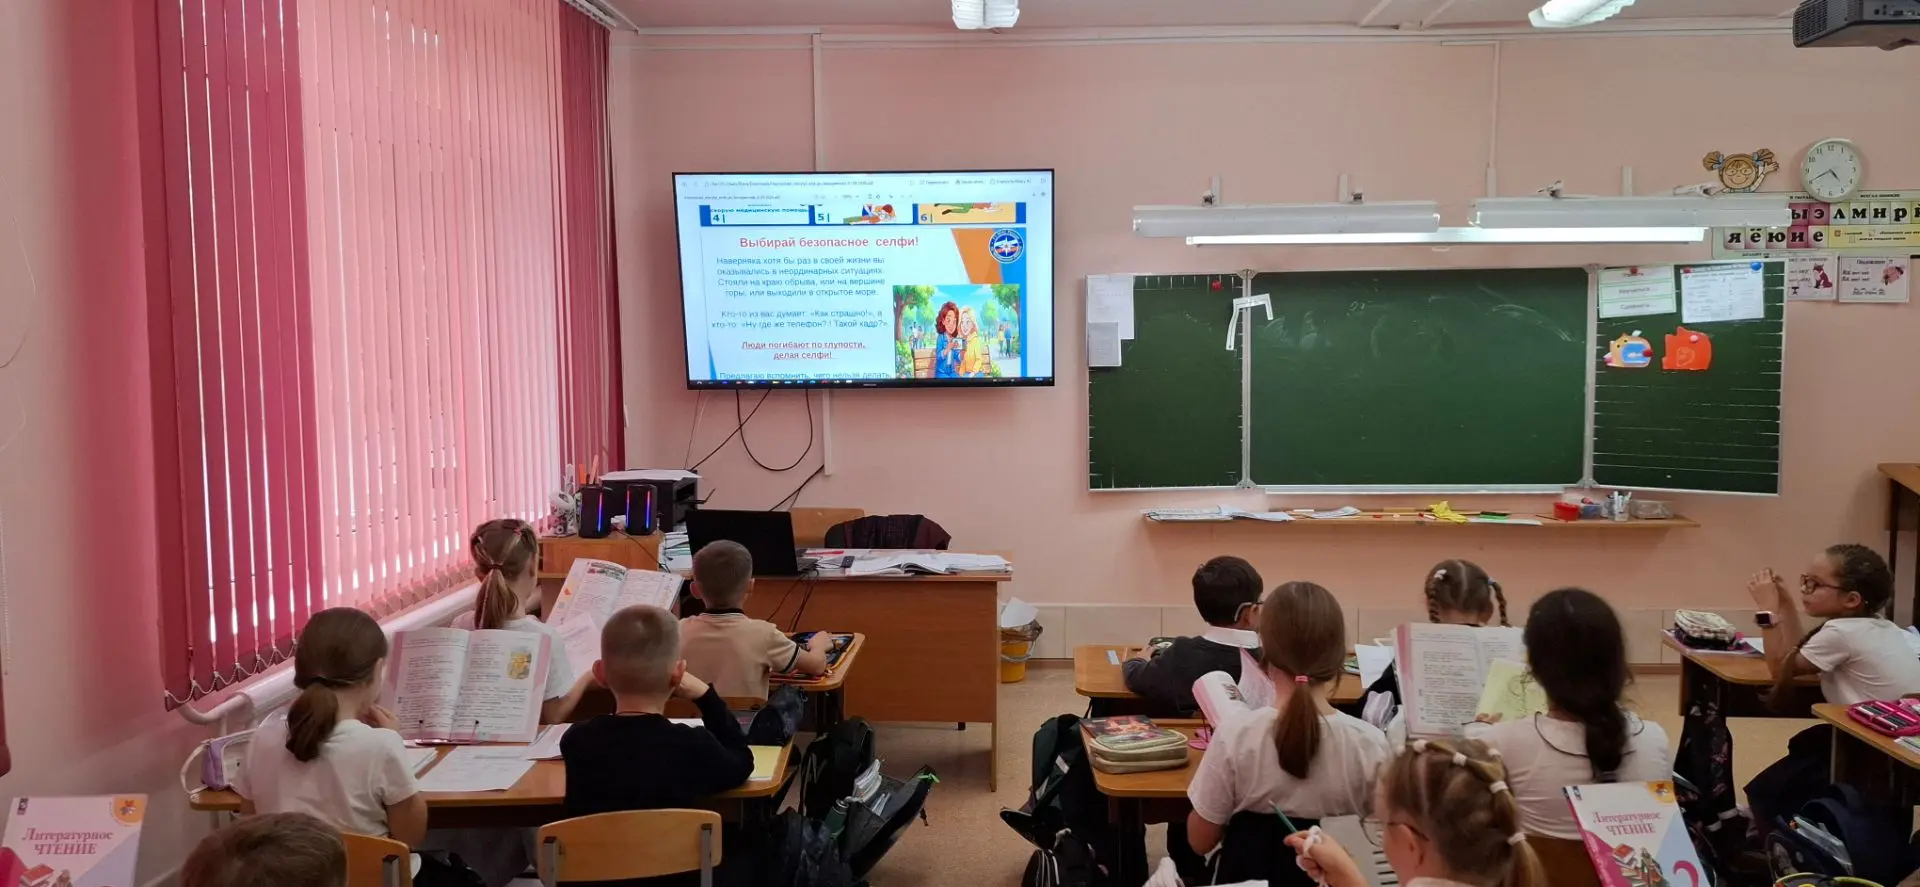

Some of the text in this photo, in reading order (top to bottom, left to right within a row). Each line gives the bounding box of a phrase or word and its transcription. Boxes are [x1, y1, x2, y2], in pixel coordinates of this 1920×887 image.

[713, 214, 720, 222] 4
[817, 213, 825, 221] 5
[920, 213, 928, 222] 6
[1814, 208, 1825, 219] э
[1833, 208, 1845, 219] л
[1852, 208, 1867, 219] м
[1873, 208, 1887, 218] н
[1893, 207, 1908, 221] р
[1728, 228, 1824, 243] я ё ю и е
[739, 236, 919, 249] Выбирай безопасное селфи!
[716, 257, 761, 266] Наверняка
[763, 257, 781, 265] хотя
[783, 256, 795, 265] бы
[797, 257, 811, 266] раз
[820, 256, 844, 265] своей
[779, 268, 839, 276] неординарных
[815, 289, 854, 297] открытое
[742, 341, 766, 350] Люди
[768, 341, 809, 350] погибают
[773, 351, 832, 361] делая селфи!
[1592, 811, 1662, 824] Литературное
[1606, 822, 1656, 836] ЧТЕНИЕ
[22, 827, 114, 843] Литературное
[34, 843, 98, 855] ЧТЕНИЕ
